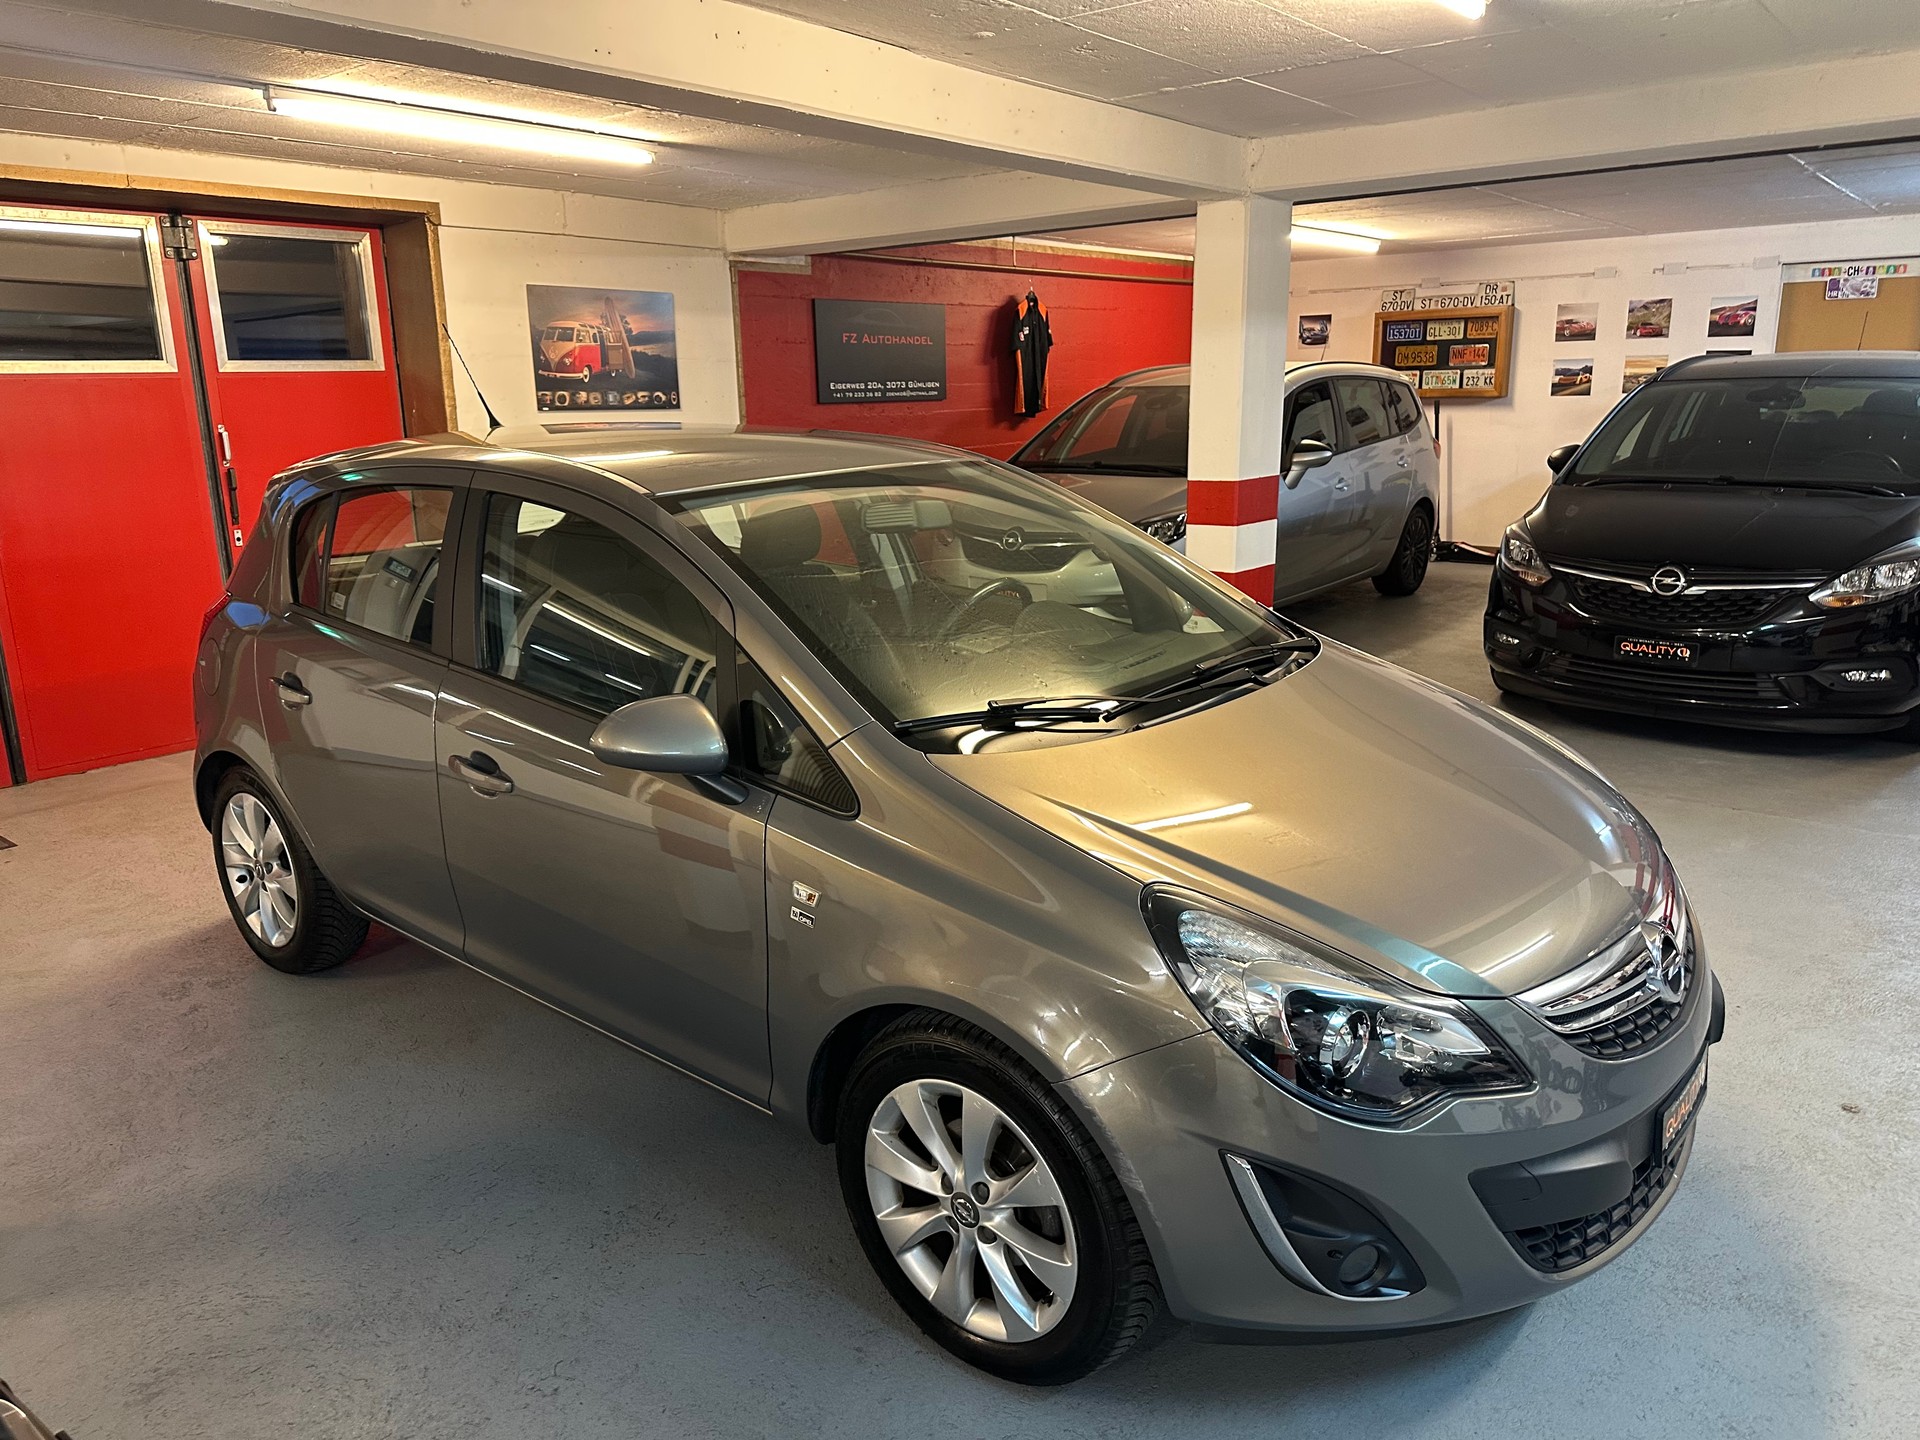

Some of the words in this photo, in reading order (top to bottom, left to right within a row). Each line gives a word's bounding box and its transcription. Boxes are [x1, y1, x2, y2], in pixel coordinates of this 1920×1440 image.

[1485, 284, 1498, 295] DR
[1392, 290, 1404, 301] ST
[1420, 298, 1433, 309] ST
[842, 333, 857, 343] FZ
[862, 334, 933, 345] AUTOHANDEL
[830, 382, 865, 390] EIGERWEG
[886, 381, 906, 389] 3073
[1465, 376, 1480, 386] 232
[1484, 375, 1494, 386] KK
[1620, 642, 1677, 656] QUALITY
